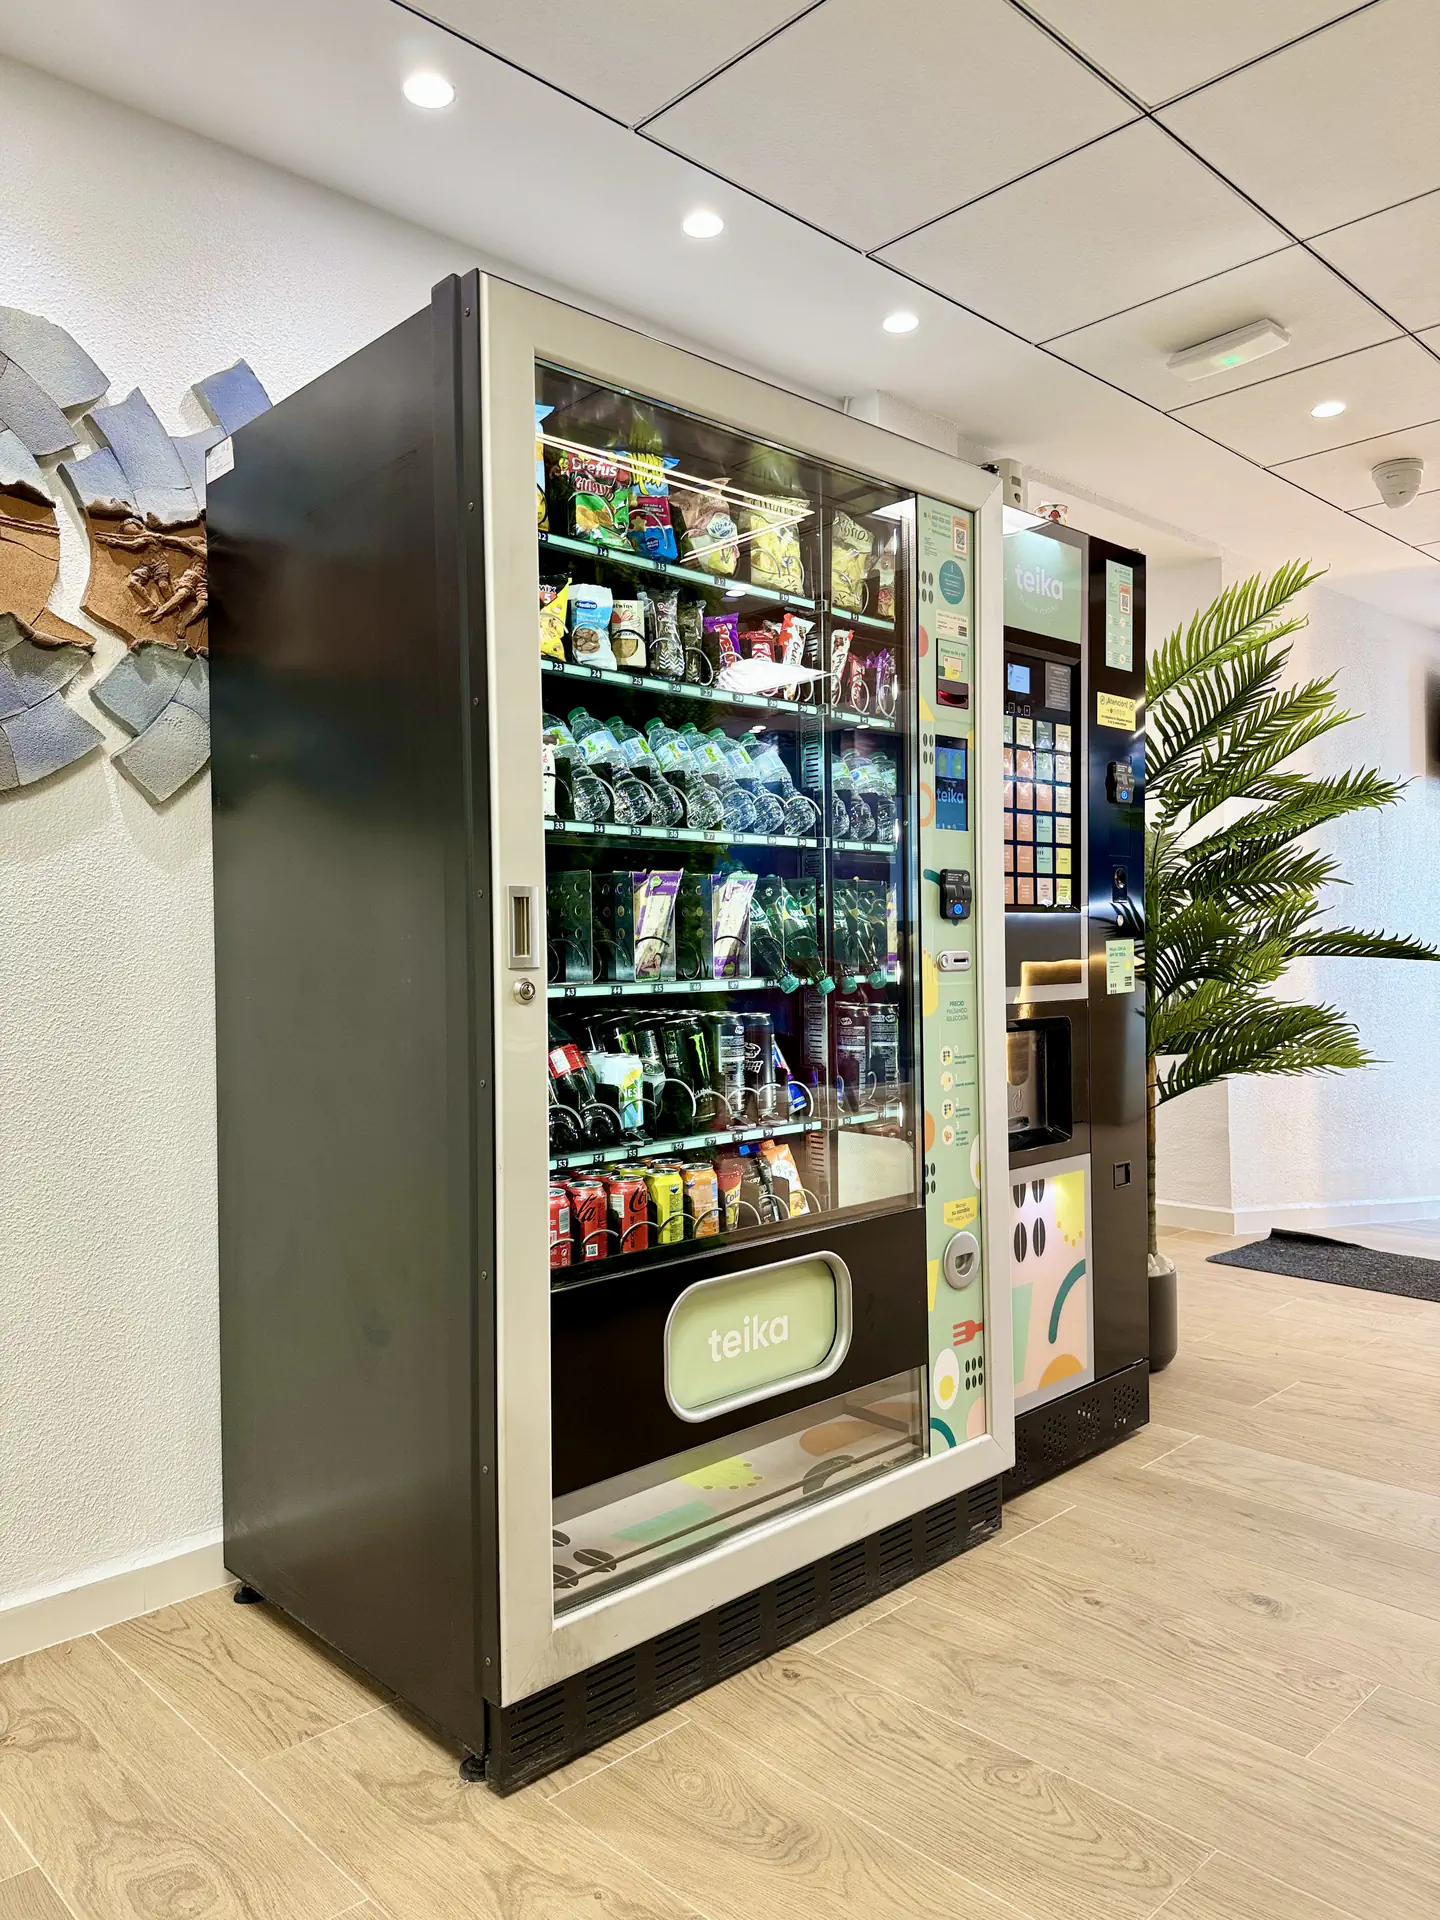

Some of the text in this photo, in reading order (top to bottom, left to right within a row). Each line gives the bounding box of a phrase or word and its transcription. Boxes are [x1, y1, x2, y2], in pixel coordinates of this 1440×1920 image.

[599, 547, 607, 556] 14
[657, 563, 665, 571] 15
[1014, 563, 1064, 601] teika
[553, 663, 563, 671] 23
[592, 670, 600, 678] 24
[634, 677, 642, 685] 25
[672, 684, 680, 692] 26
[936, 788, 964, 804] teika
[554, 822, 564, 830] 33
[594, 825, 604, 833] 34
[669, 830, 678, 838] 36
[612, 986, 621, 994] 44
[955, 1098, 959, 1107] 2
[955, 1121, 960, 1131] 3
[765, 1129, 773, 1138] 59
[674, 1142, 683, 1150] 56
[628, 1149, 637, 1157] 55
[594, 1155, 603, 1163] 54
[558, 1160, 567, 1168] 53
[708, 1315, 789, 1362] teika
